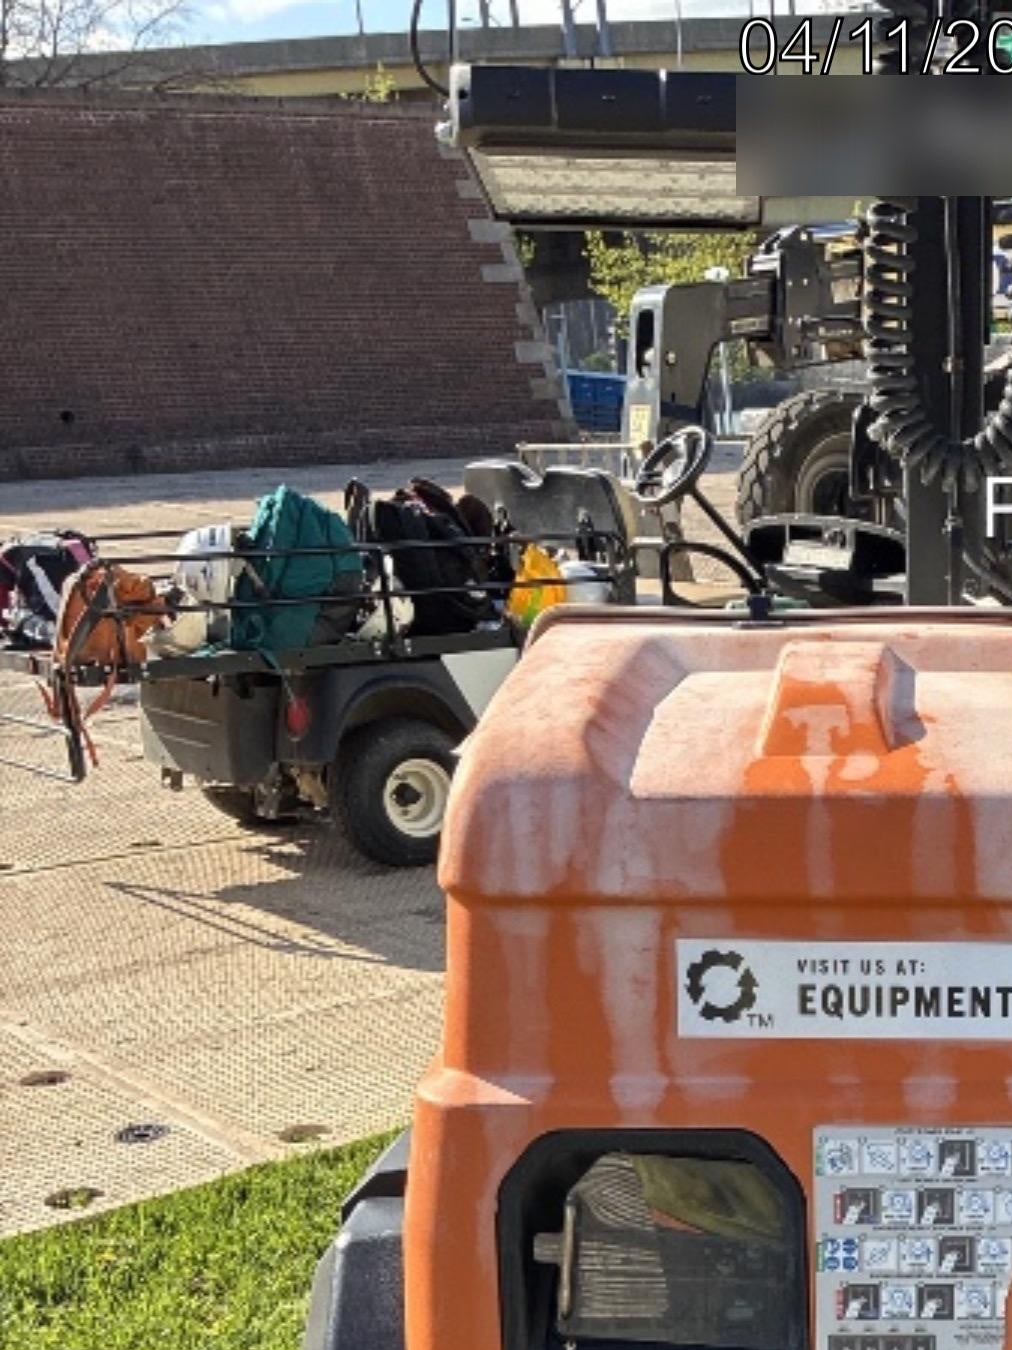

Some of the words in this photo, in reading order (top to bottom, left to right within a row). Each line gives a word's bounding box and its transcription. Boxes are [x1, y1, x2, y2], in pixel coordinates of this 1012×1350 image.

[797, 959, 850, 975] VISIT
[860, 960, 886, 976] US
[896, 960, 926, 977] AT:
